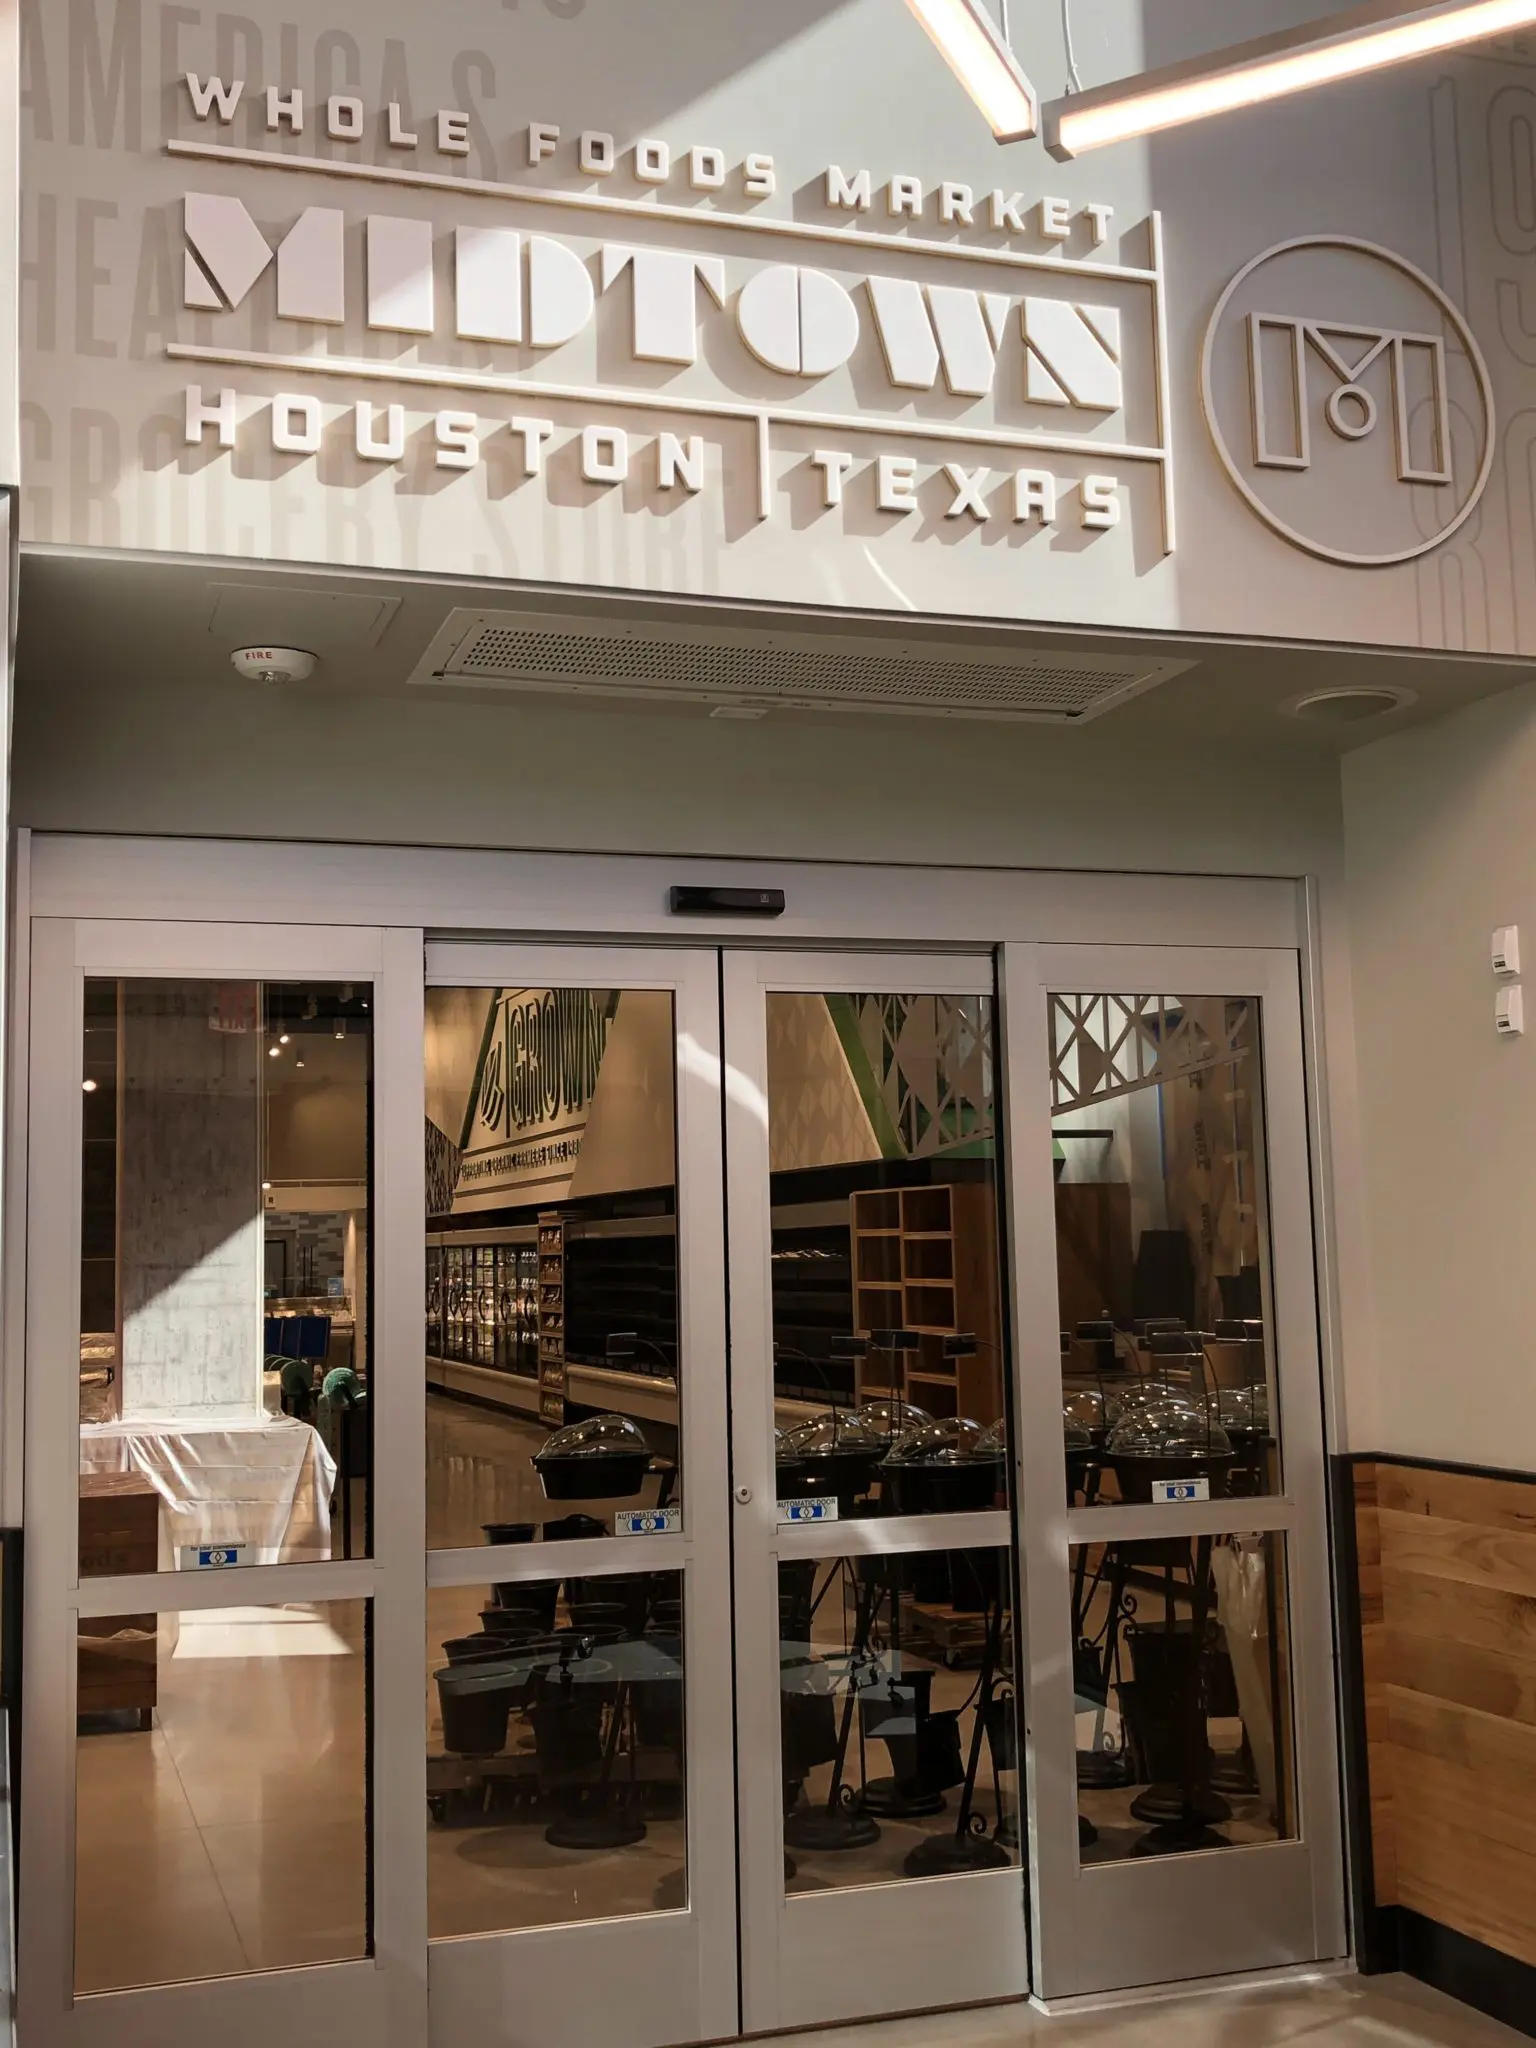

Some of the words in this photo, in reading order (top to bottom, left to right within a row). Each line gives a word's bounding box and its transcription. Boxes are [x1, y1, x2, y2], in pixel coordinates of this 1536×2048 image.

[184, 71, 471, 157] WHOLE
[528, 121, 777, 198] FOODS
[825, 163, 1115, 245] MARKET
[183, 190, 1124, 413] MIDTOWN
[184, 383, 704, 493] HOUSTON
[812, 448, 1120, 530] TEXAS
[245, 651, 273, 660] FIRE
[617, 1511, 657, 1520] AUTOMATIC
[659, 1509, 680, 1517] DOOR
[777, 1500, 815, 1508] AUTOMATIC
[816, 1498, 836, 1506] DOOR
